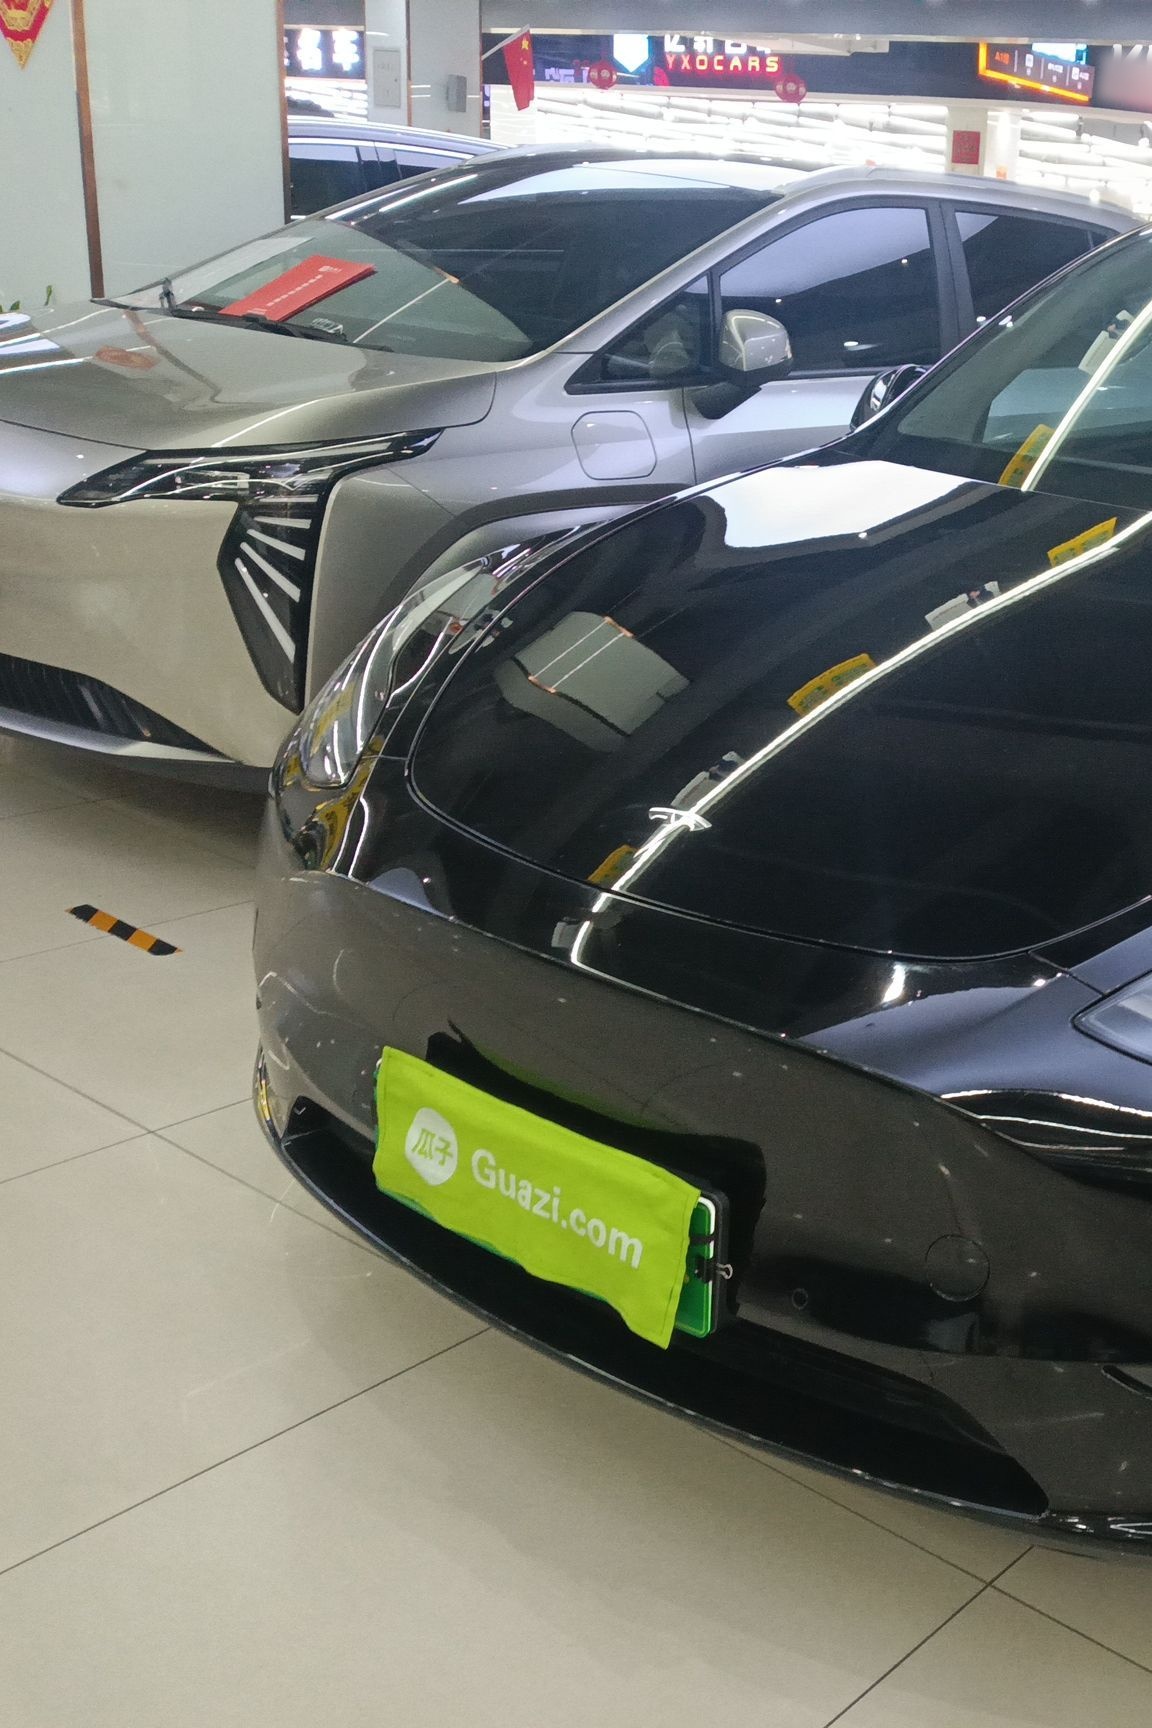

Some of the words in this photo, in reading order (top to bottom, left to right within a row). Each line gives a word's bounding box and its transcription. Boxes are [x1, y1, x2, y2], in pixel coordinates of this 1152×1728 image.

[665, 54, 779, 73] YXOCARS
[410, 1127, 453, 1166] 瓜子
[471, 1148, 644, 1270] Guazi.com
